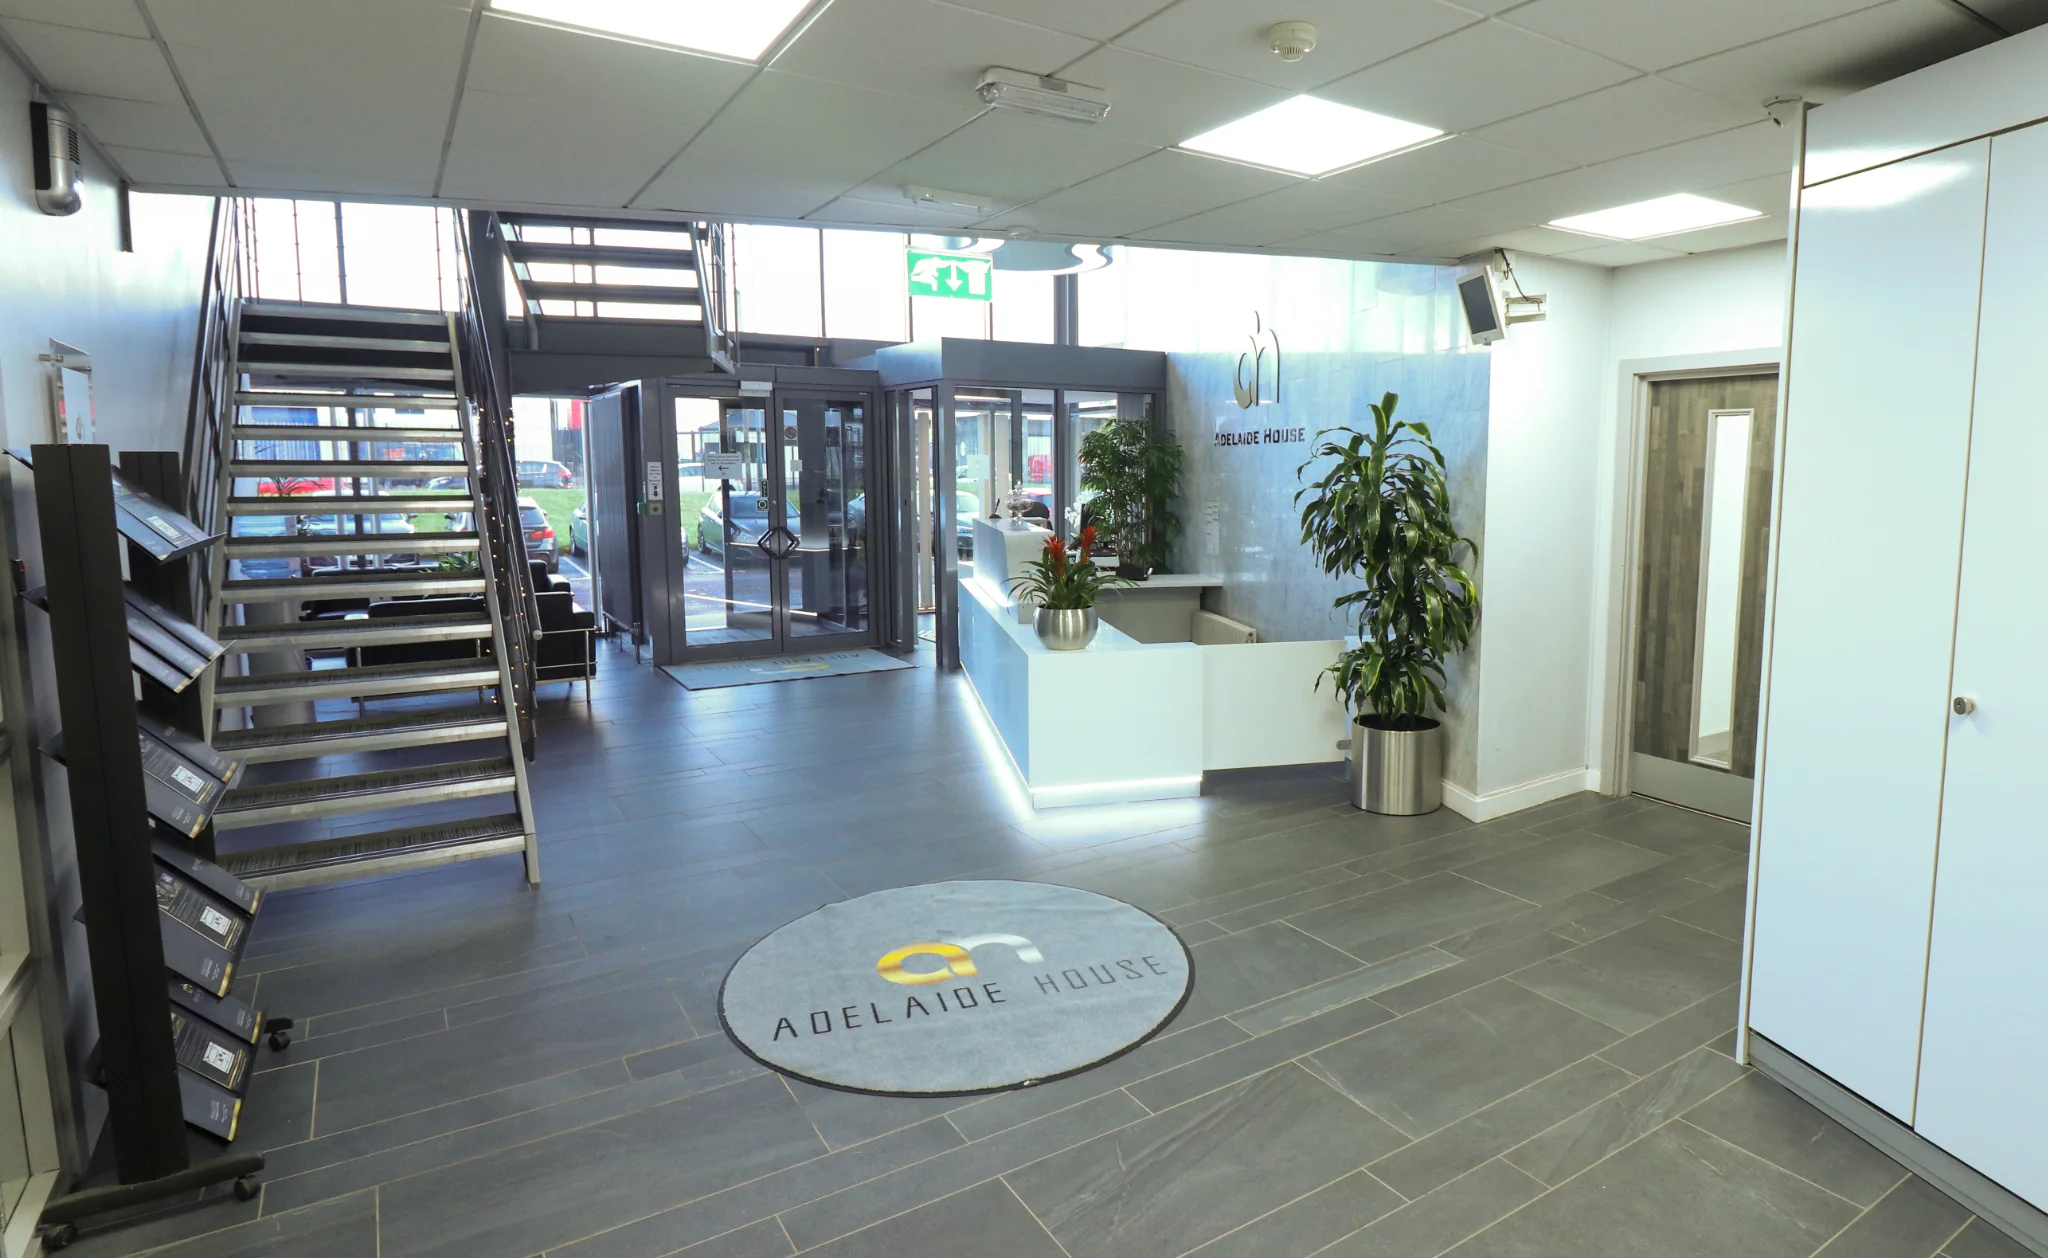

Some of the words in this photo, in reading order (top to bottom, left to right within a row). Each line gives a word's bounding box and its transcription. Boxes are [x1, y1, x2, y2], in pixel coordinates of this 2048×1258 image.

[1263, 427, 1306, 444] HOUSE
[772, 981, 1007, 1041] ADELAIDE
[1033, 955, 1170, 995] HOUSE
